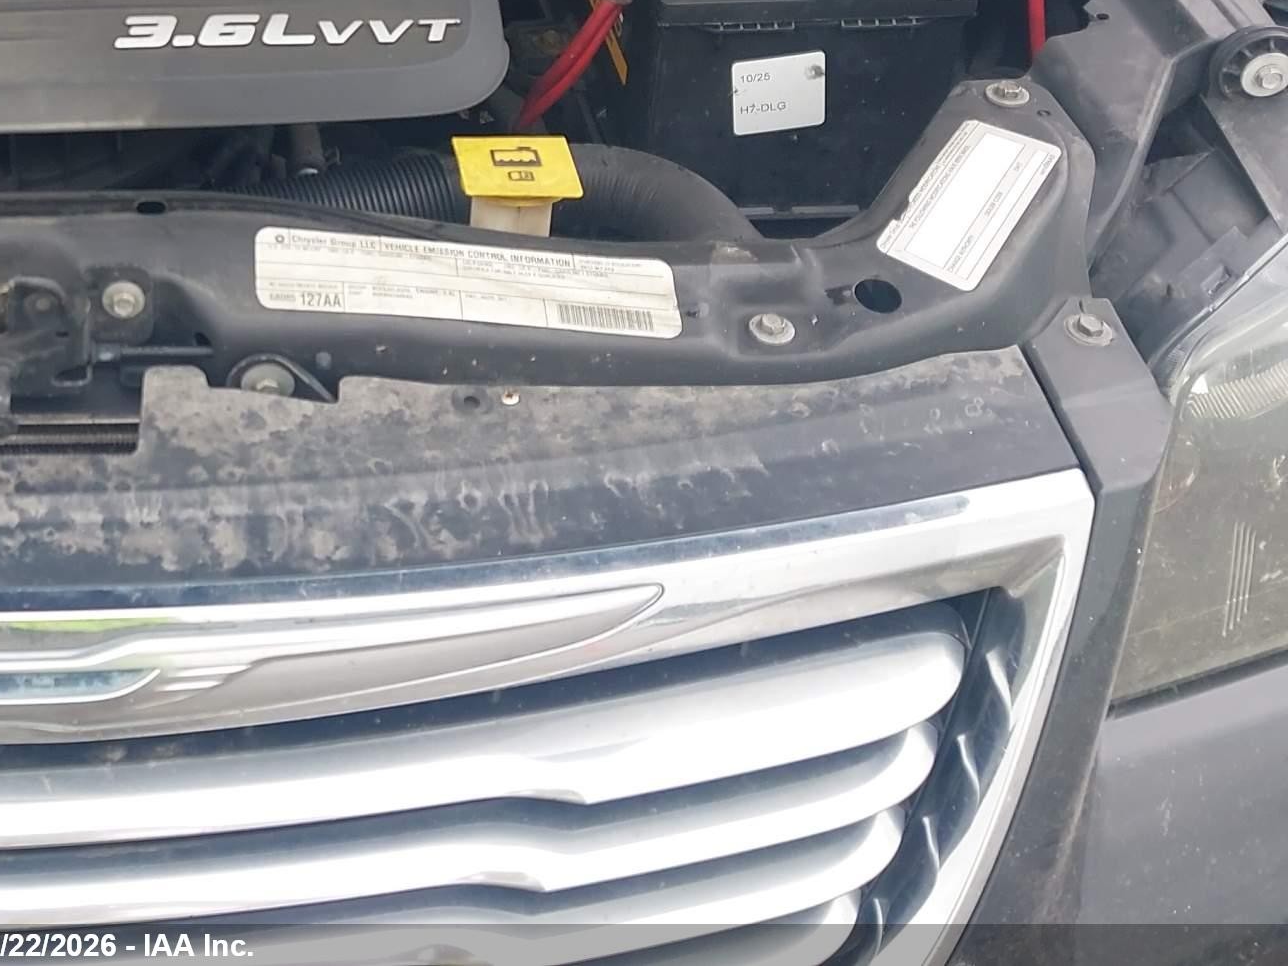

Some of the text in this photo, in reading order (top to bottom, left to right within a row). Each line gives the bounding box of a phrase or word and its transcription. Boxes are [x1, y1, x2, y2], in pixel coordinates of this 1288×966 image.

[740, 101, 787, 114] H7-DLG
[383, 241, 419, 253] VEHICLE
[422, 244, 465, 257] EMISSION
[467, 249, 507, 261] CONTROL
[510, 253, 572, 268] INFORMATION
[300, 291, 343, 308] 127AA
